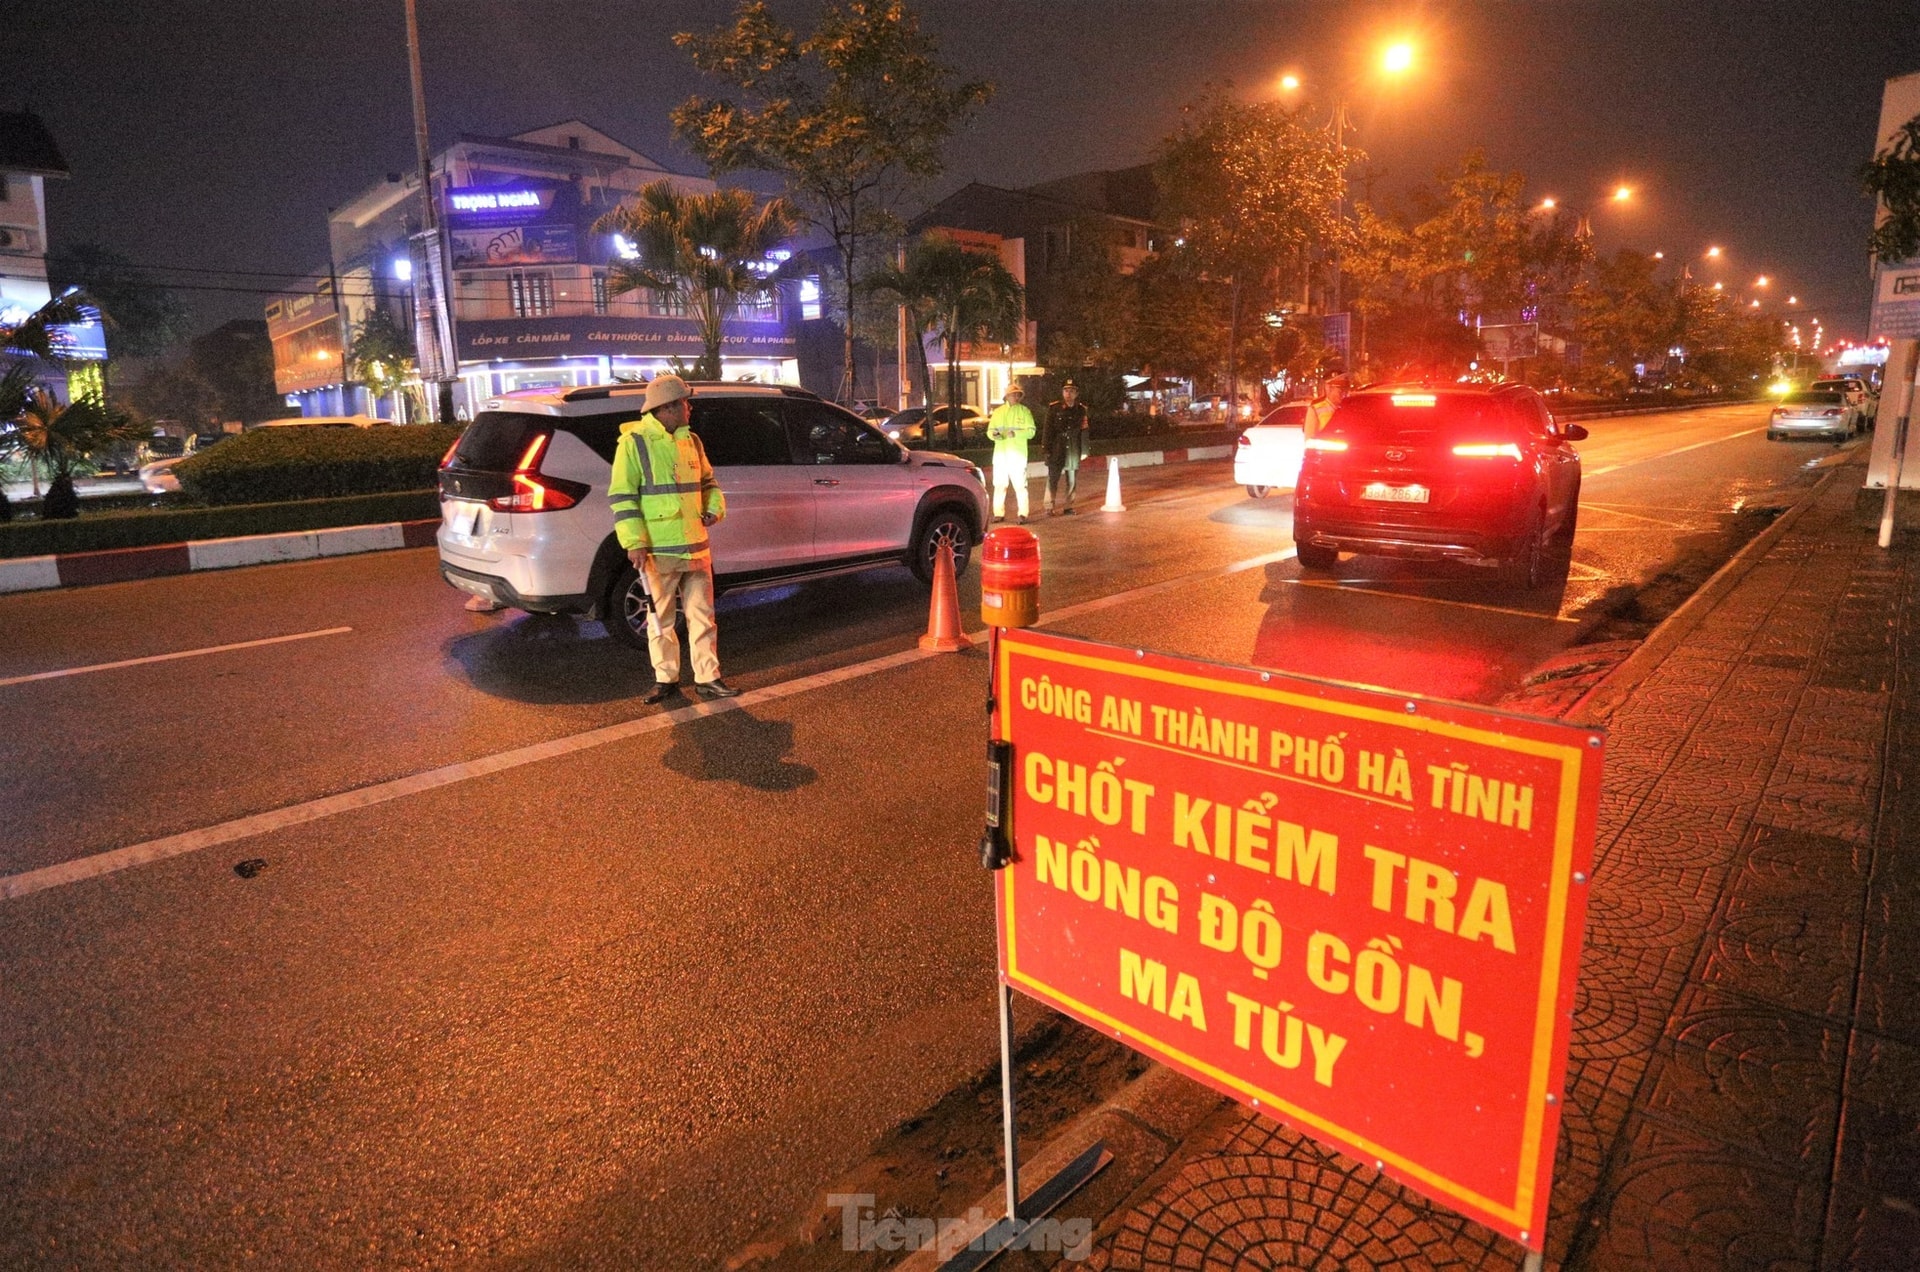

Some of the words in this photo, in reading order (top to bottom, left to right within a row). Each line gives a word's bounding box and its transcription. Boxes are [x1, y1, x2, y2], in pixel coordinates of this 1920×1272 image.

[452, 193, 497, 212] TRỌNG
[494, 336, 510, 344] XE
[516, 331, 540, 343] CÂN
[541, 331, 571, 343] MÂM
[587, 331, 611, 341] CÂN
[645, 332, 662, 342] LÁI
[1021, 675, 1091, 724] CÔNG
[1101, 695, 1141, 736] AN
[1150, 706, 1259, 764] THÀNH
[1270, 731, 1348, 784] PHỐ
[1358, 748, 1413, 802] HÀ
[1427, 762, 1534, 831] TĨNH
[1024, 752, 1155, 835] CHỐT
[1173, 792, 1339, 895] KIỂM
[1364, 844, 1517, 954] TRA
[1035, 834, 1179, 935] NỒNG
[1197, 892, 1283, 981] ĐỘ
[1306, 931, 1485, 1058] CỒN,
[1119, 947, 1208, 1032] MA
[1226, 991, 1348, 1088] TÚY
